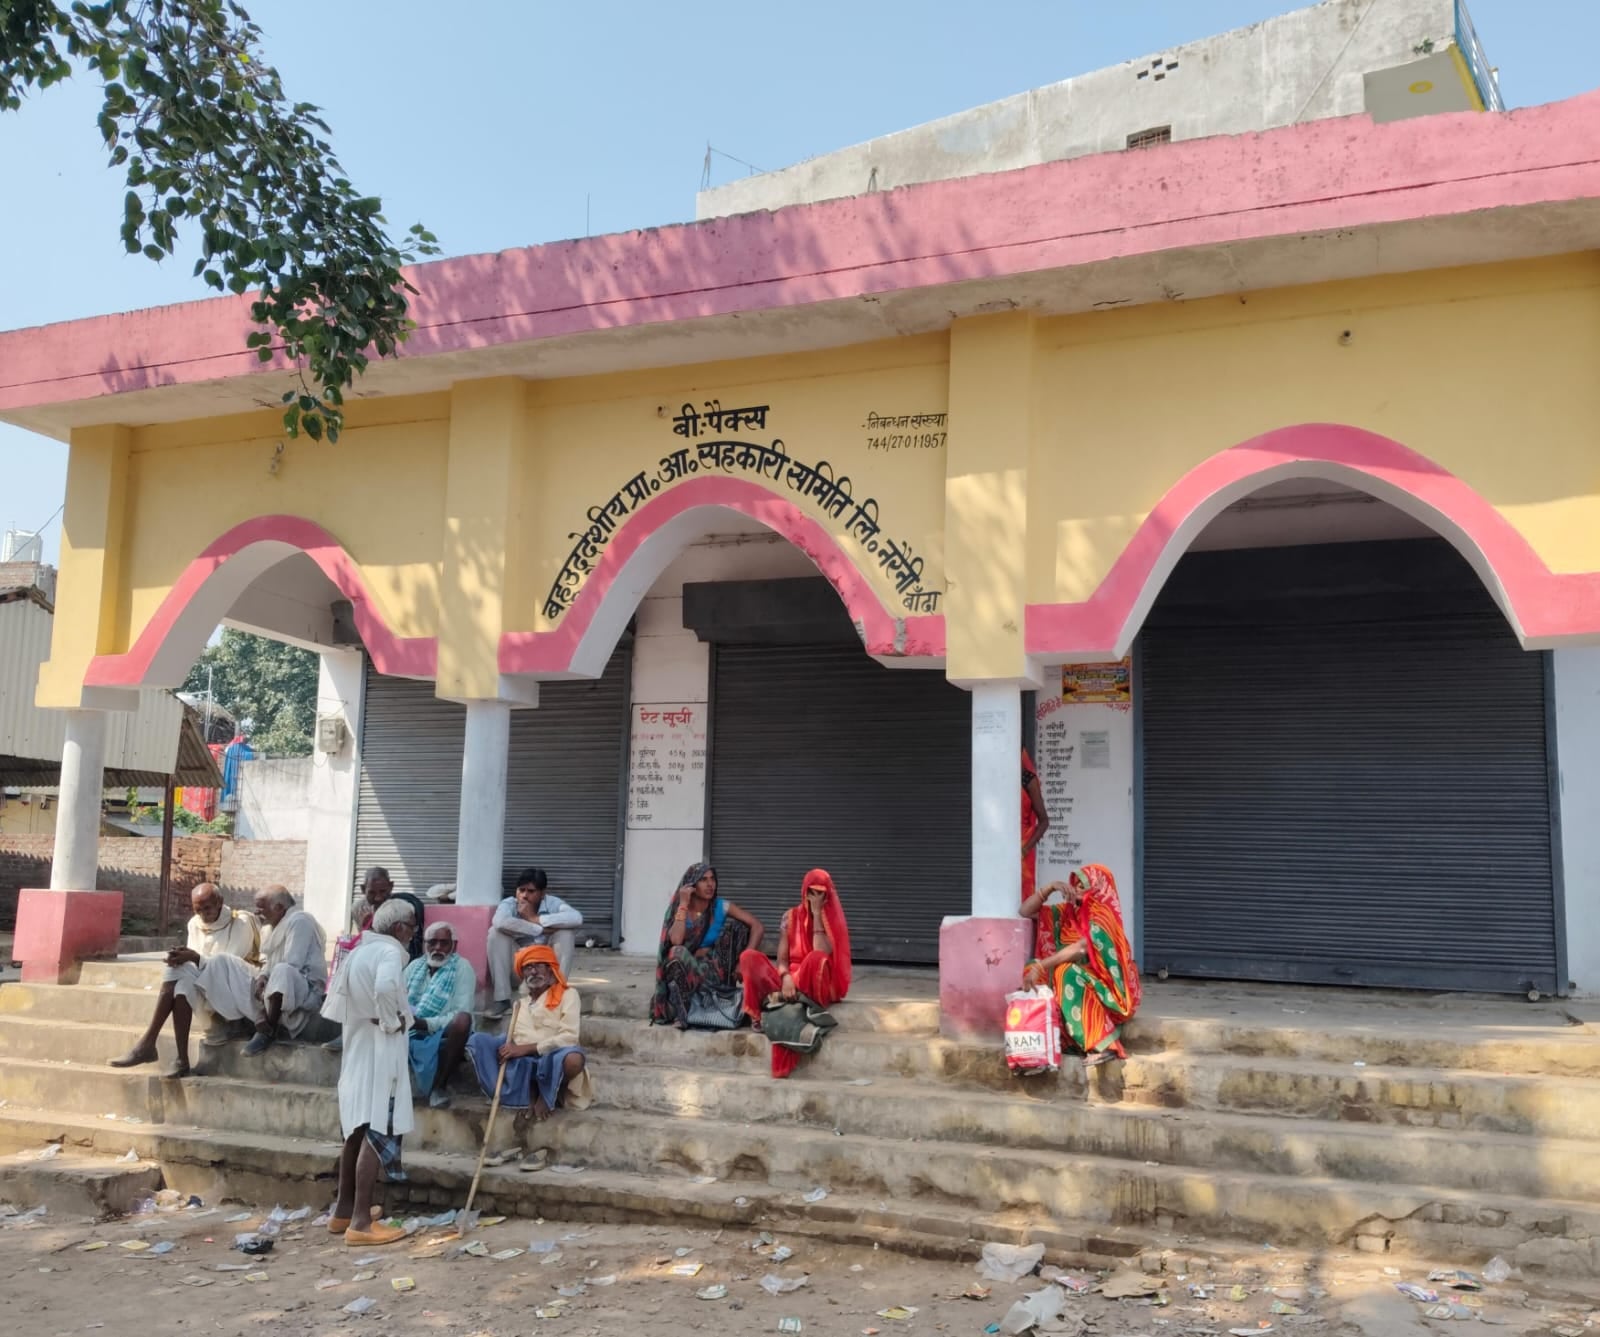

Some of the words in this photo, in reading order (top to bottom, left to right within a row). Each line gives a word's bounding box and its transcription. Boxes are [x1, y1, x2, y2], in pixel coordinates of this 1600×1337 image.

[697, 439, 790, 482] सहकारी
[786, 461, 855, 520] समिति
[639, 706, 660, 724] रेट
[663, 706, 693, 728] सूची
